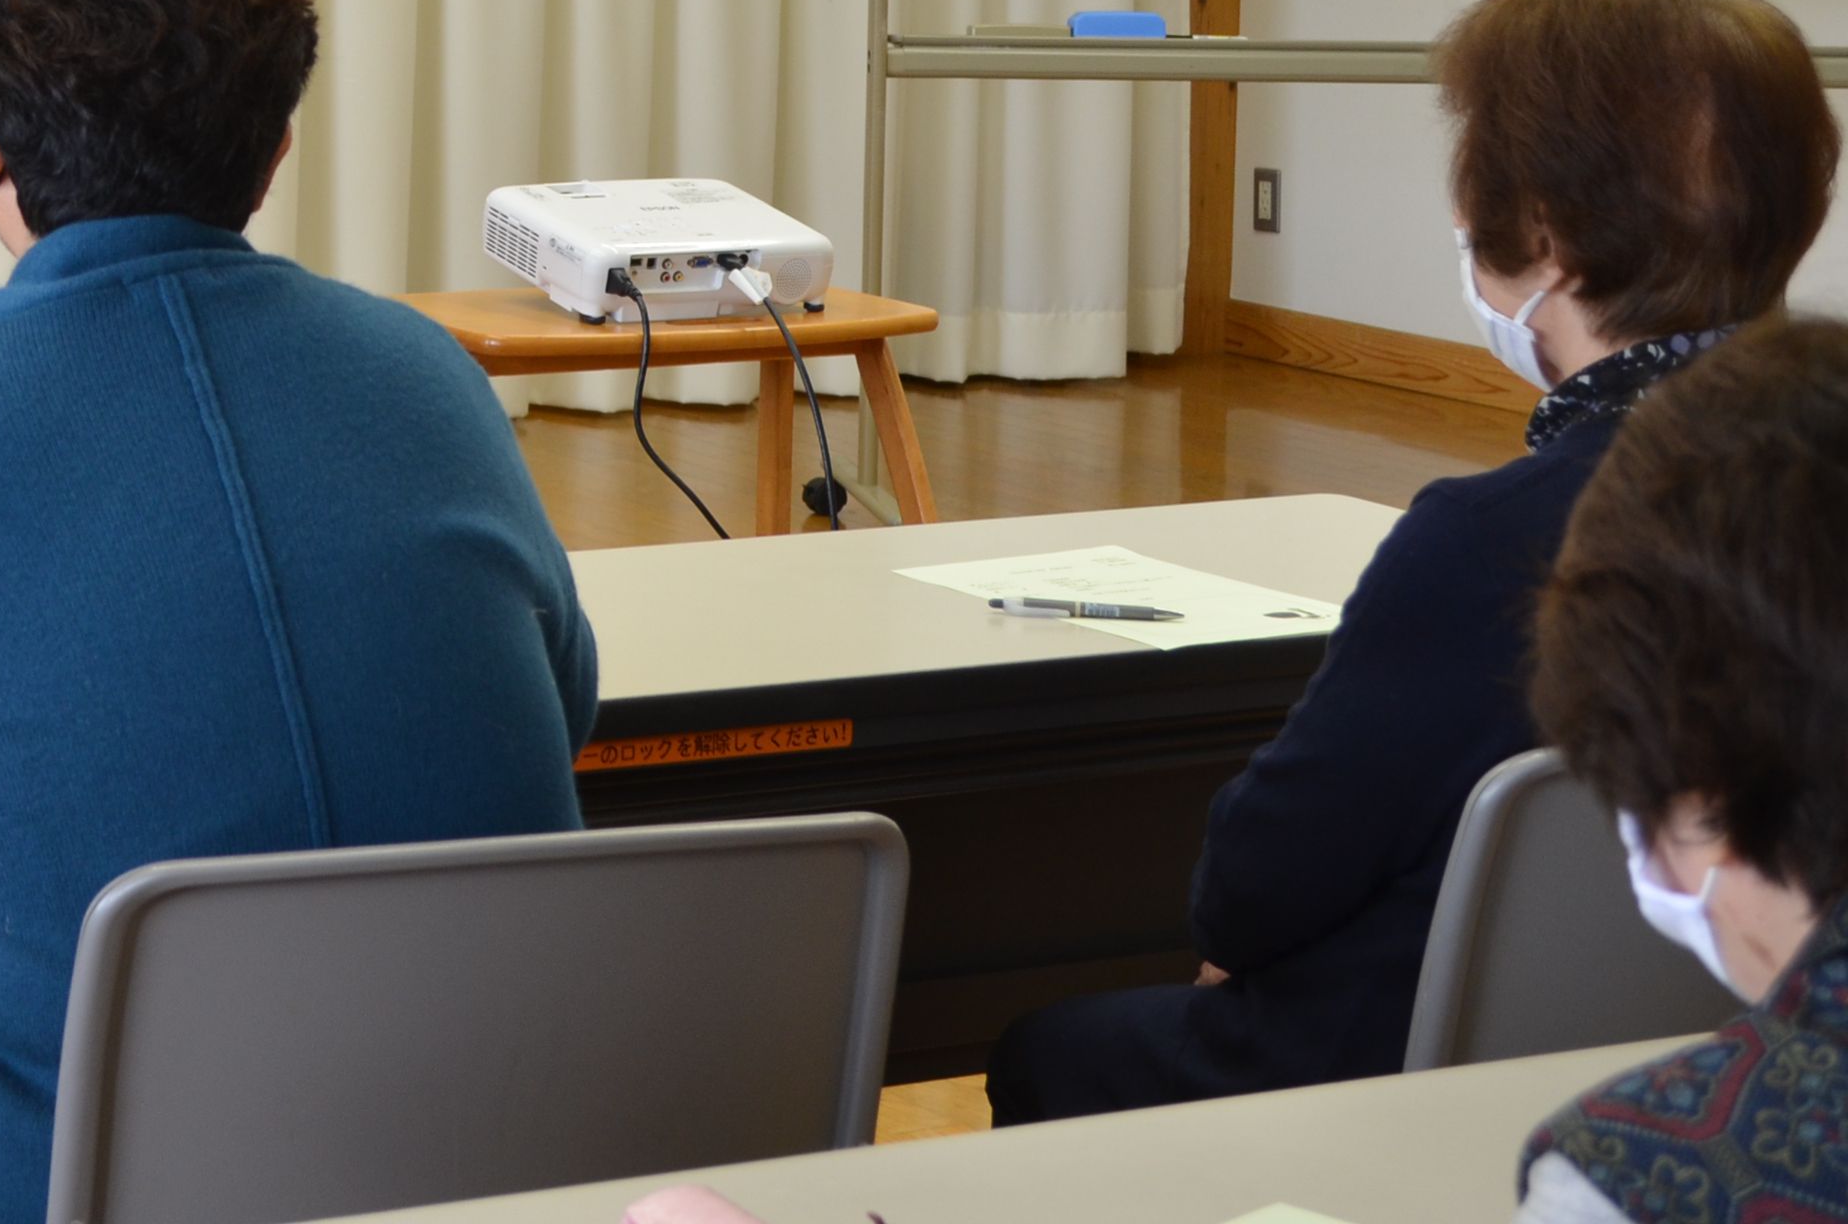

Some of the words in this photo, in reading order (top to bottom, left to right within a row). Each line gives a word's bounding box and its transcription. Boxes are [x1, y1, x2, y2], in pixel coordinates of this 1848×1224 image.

[572, 722, 848, 764] ーのロックを解除してください!
